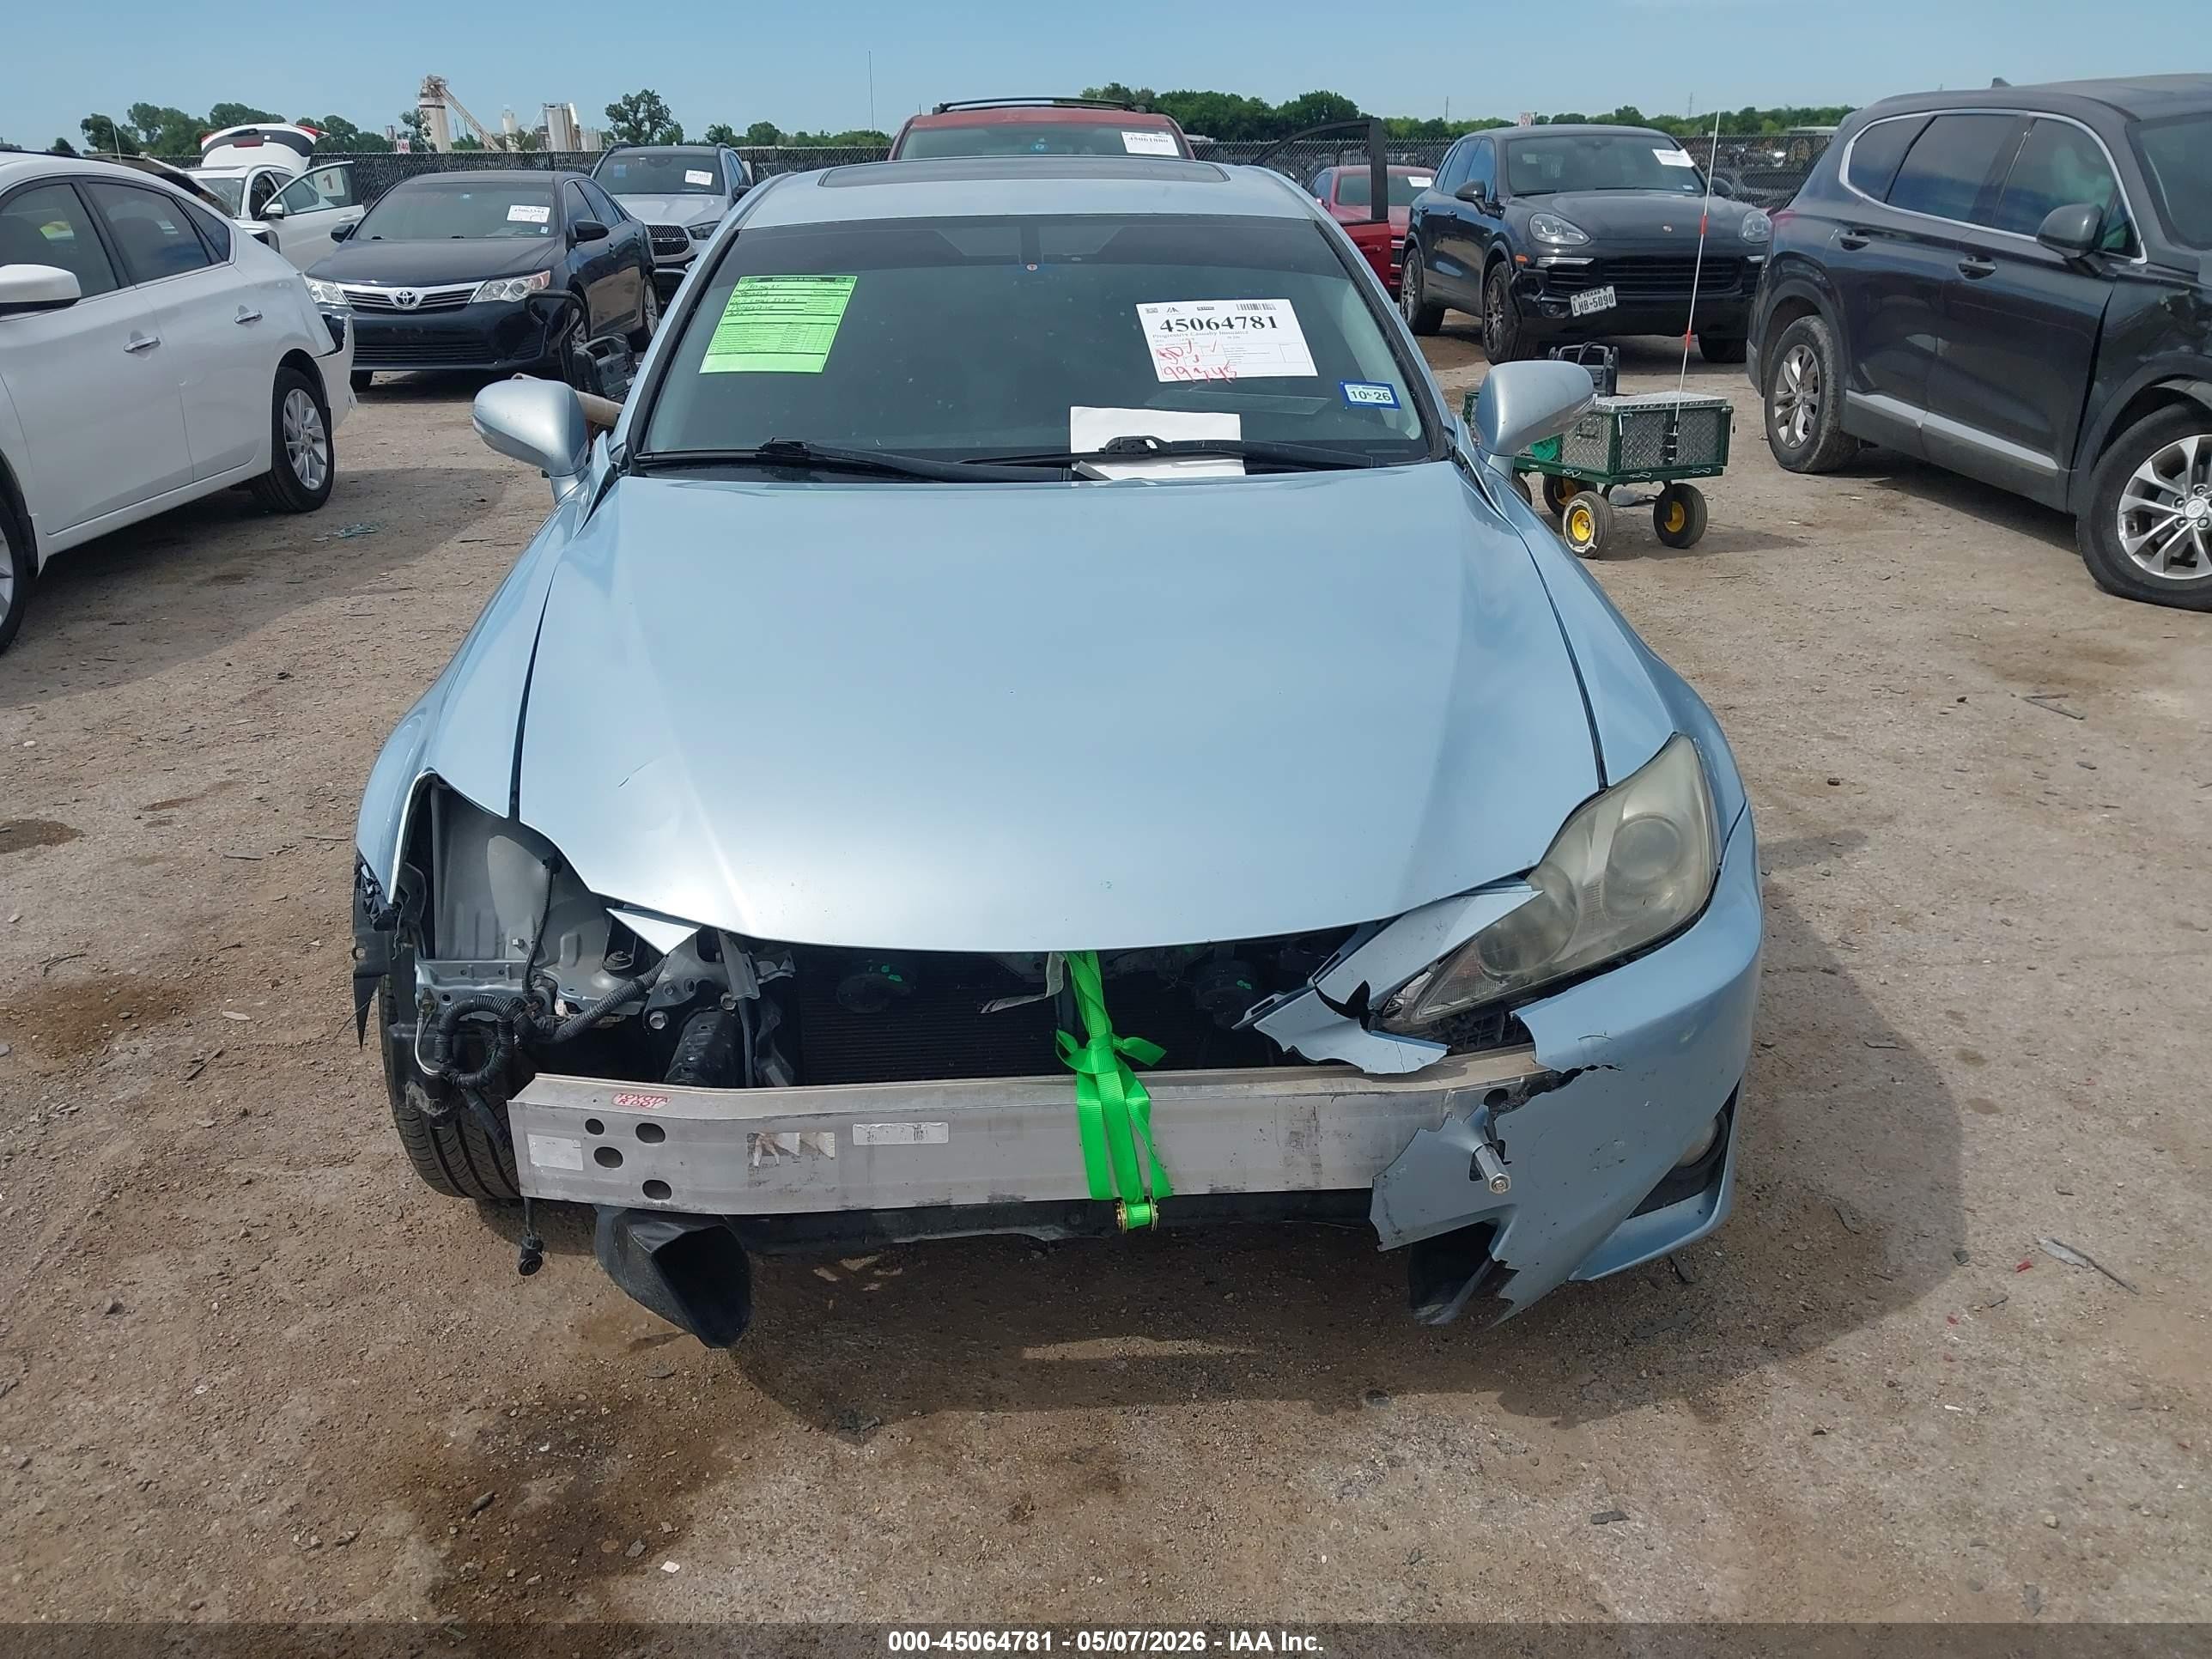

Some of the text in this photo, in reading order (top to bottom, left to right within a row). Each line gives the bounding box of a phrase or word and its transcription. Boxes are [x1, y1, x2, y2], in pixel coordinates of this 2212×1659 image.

[323, 174, 333, 190] 1
[1572, 293, 1614, 313] LHB-5090
[1159, 315, 1278, 332] 45064781
[1350, 390, 1391, 401] 10 26
[618, 1093, 668, 1103] TOYOTA
